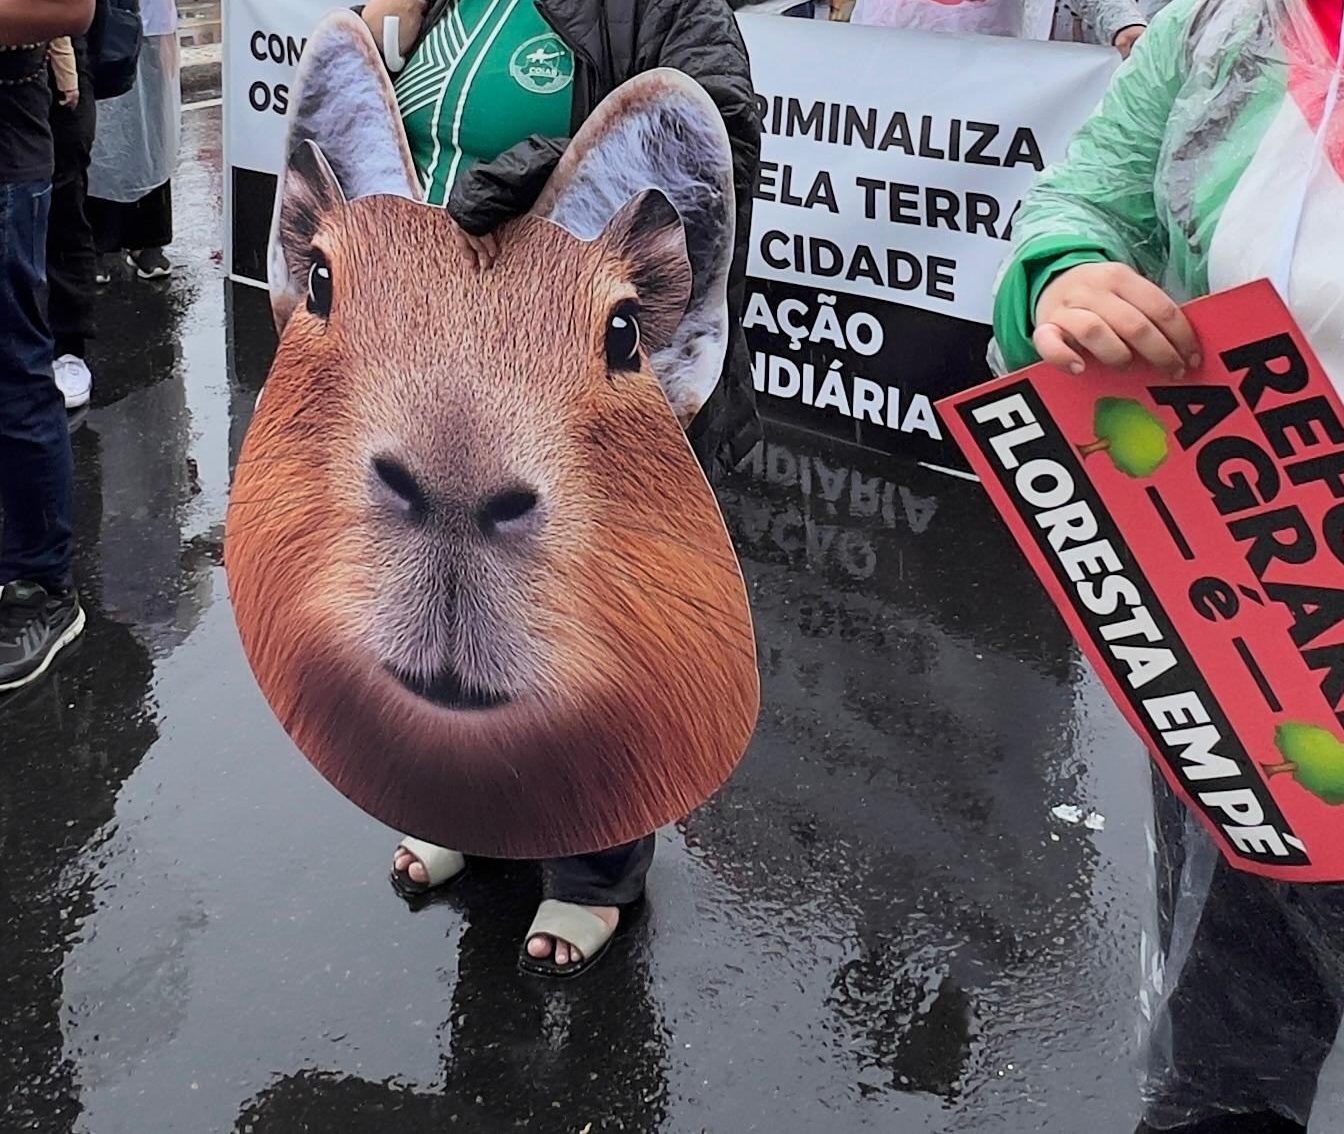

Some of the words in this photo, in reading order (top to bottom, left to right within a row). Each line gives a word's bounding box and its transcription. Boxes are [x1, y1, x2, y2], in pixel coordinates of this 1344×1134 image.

[248, 80, 290, 115] OS
[759, 229, 957, 302] CIDADE
[742, 291, 885, 356] AÇÃO
[971, 392, 1179, 690] FLORESTA
[1142, 692, 1243, 782] EM
[1198, 788, 1309, 858] PÉ
